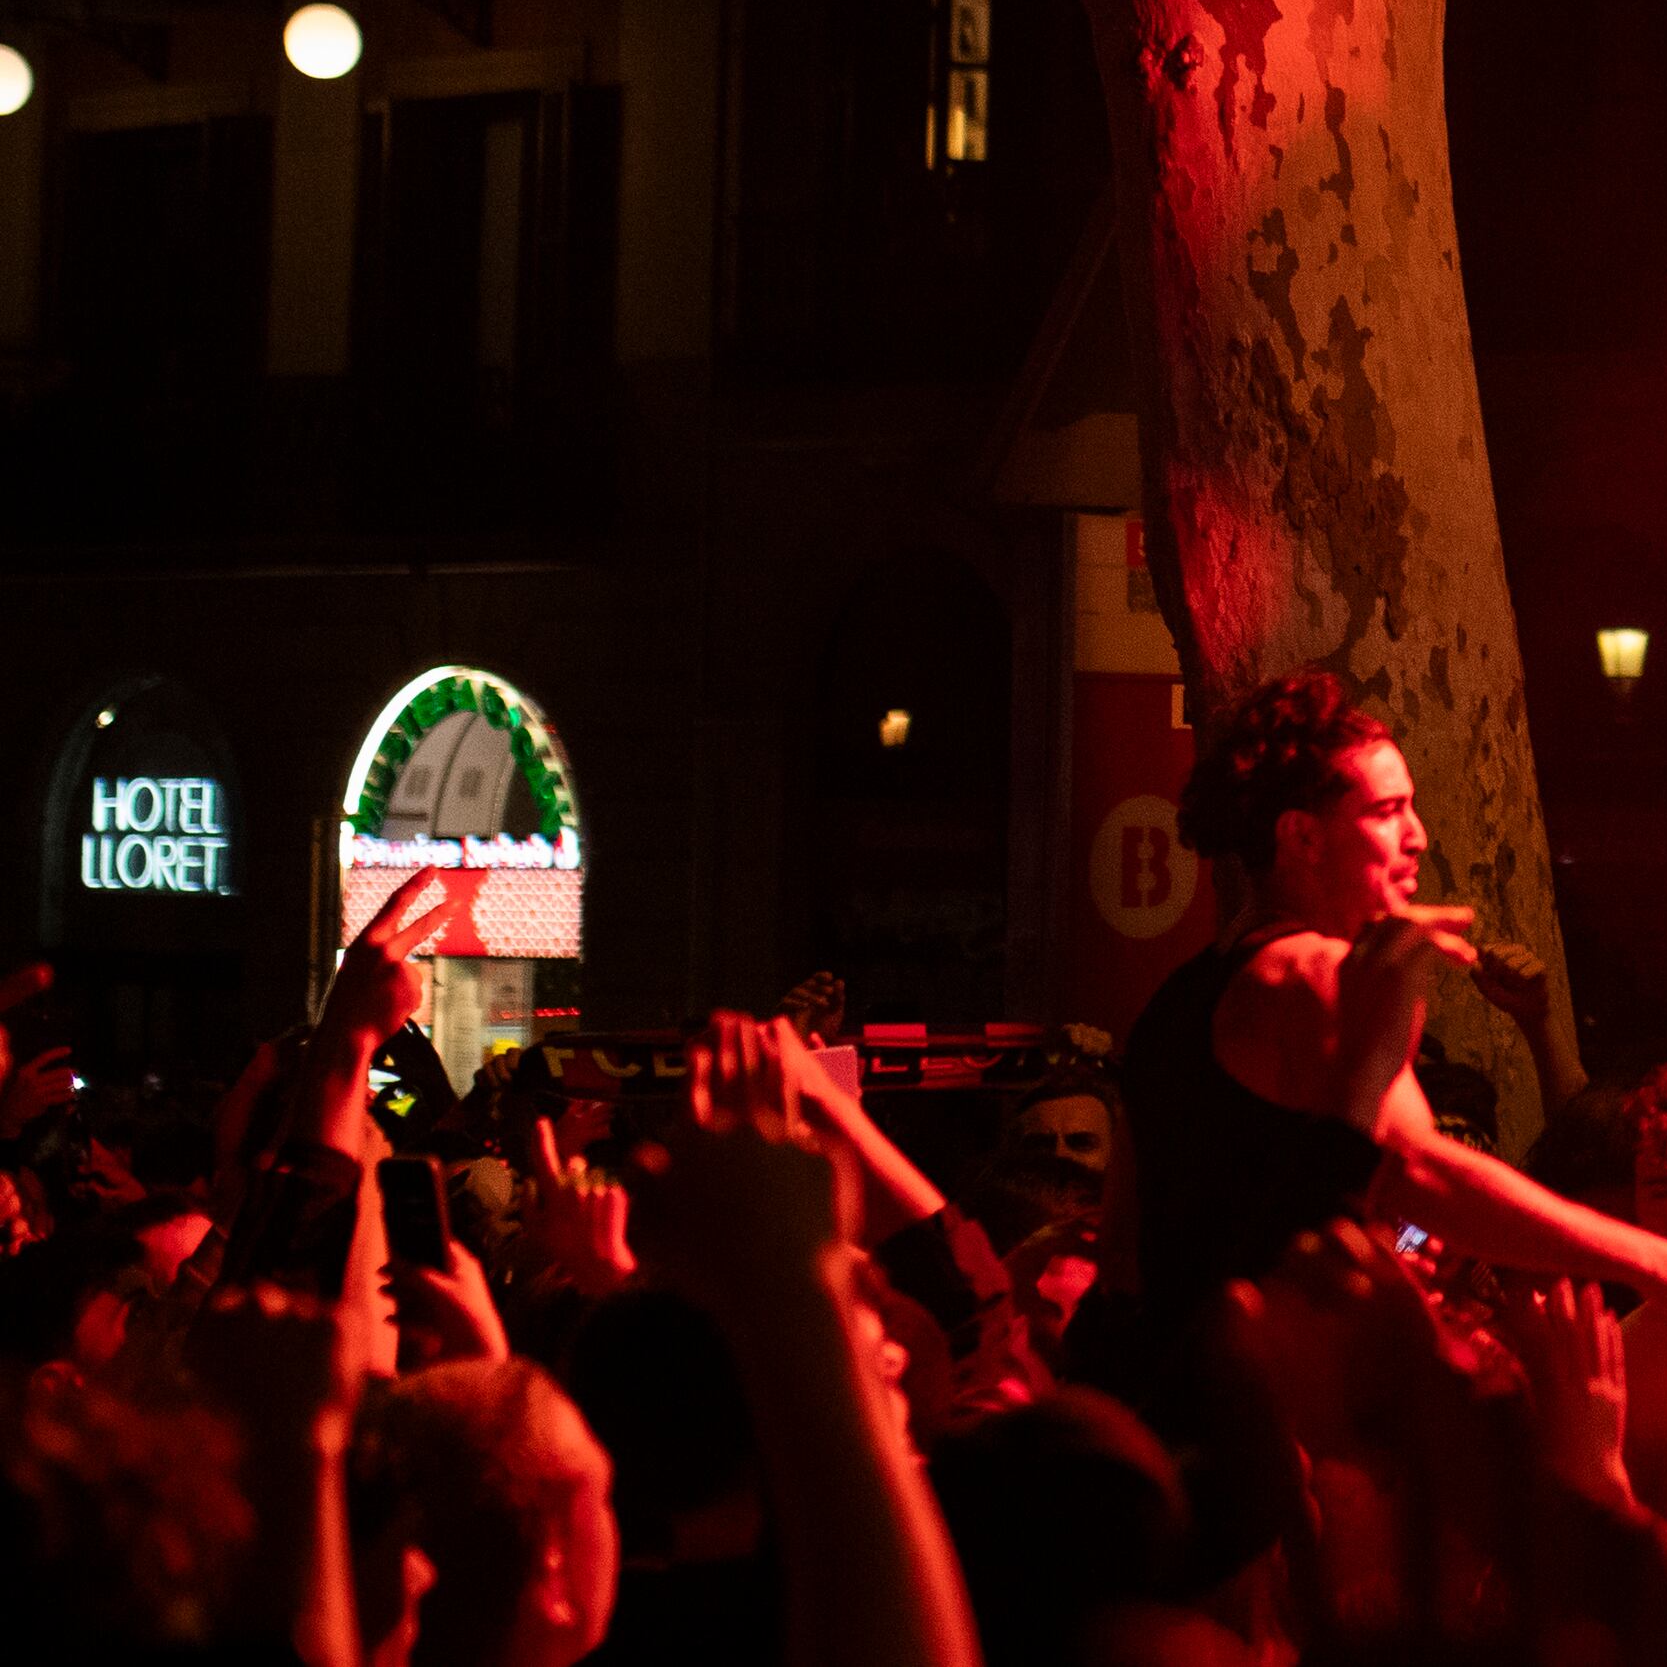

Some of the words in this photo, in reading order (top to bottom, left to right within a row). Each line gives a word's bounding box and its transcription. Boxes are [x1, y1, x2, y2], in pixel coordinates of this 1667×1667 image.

[92, 777, 223, 834] HOTEL
[81, 833, 229, 893] LLORET
[1121, 827, 1172, 909] B
